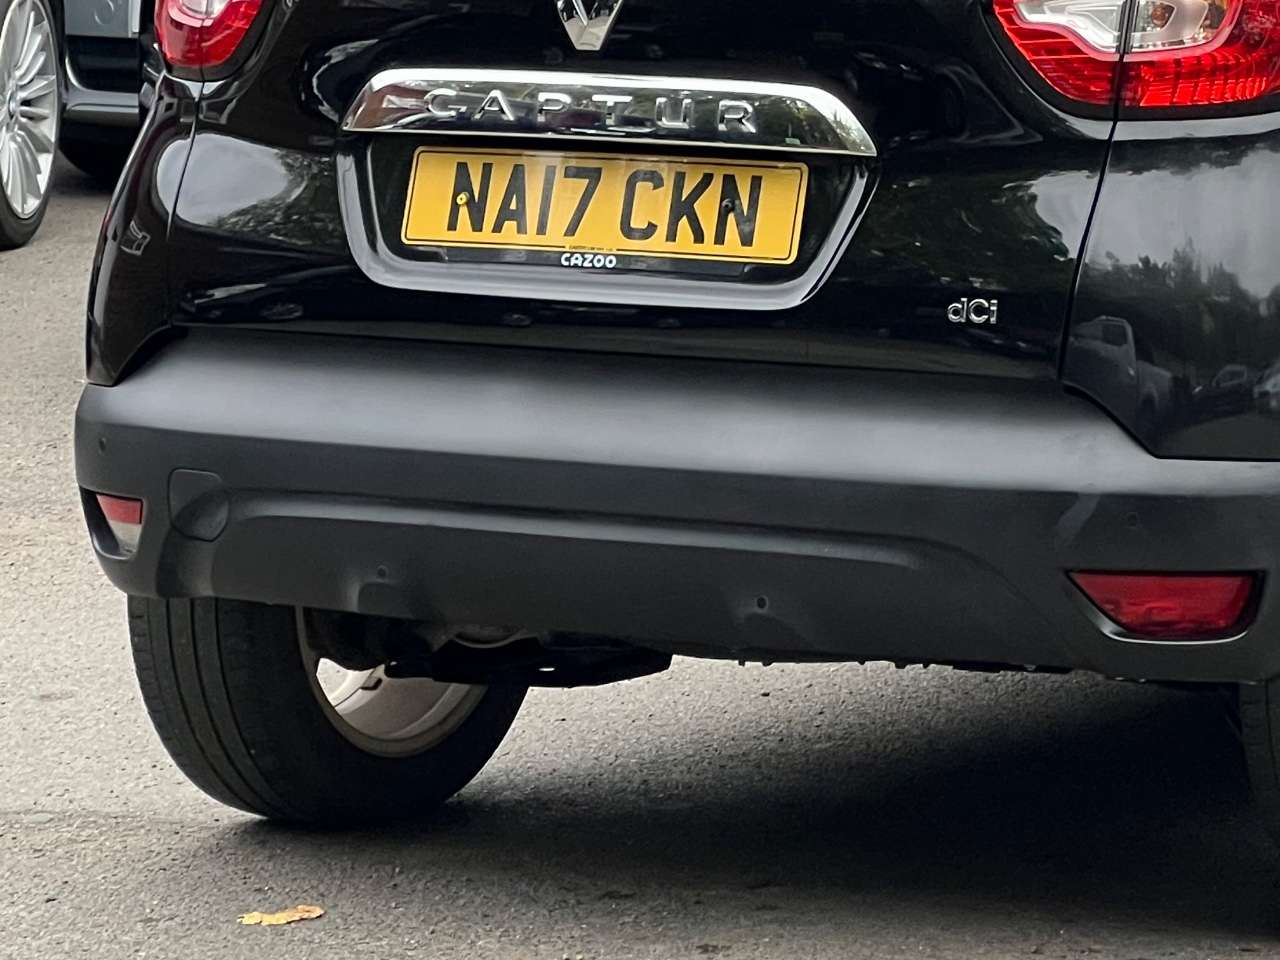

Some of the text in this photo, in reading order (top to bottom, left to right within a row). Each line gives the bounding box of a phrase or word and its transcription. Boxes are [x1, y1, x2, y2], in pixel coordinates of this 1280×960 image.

[423, 87, 757, 134] CAPTUR
[447, 161, 763, 247] NA17 CKN
[561, 253, 617, 269] CAZOO
[947, 298, 998, 324] dCi
